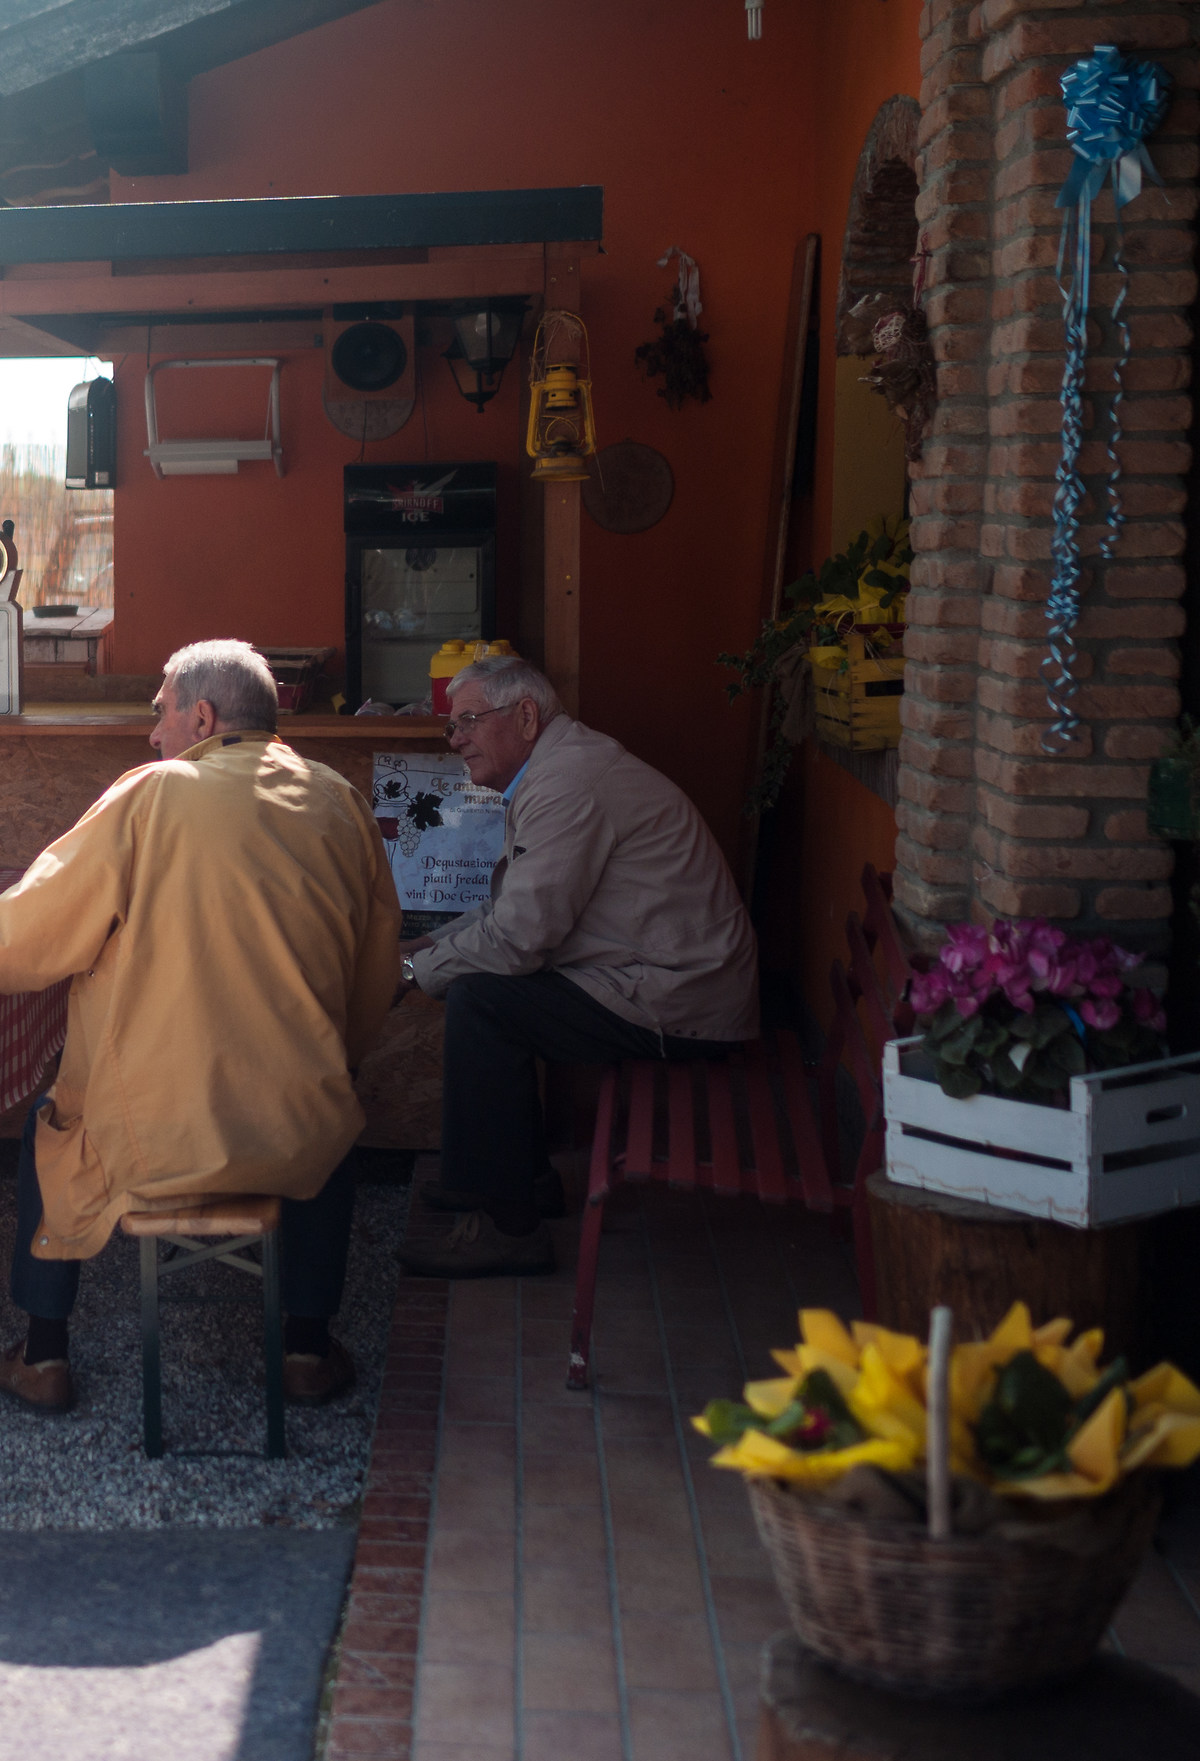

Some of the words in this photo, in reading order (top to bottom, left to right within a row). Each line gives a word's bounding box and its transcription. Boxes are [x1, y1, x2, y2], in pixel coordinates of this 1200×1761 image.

[402, 511, 430, 522] ICE
[464, 794, 501, 806] mura
[424, 874, 452, 886] piatti
[454, 874, 489, 888] freddi
[406, 889, 426, 899] vini
[430, 890, 456, 903] Doc
[460, 890, 491, 903] Grav
